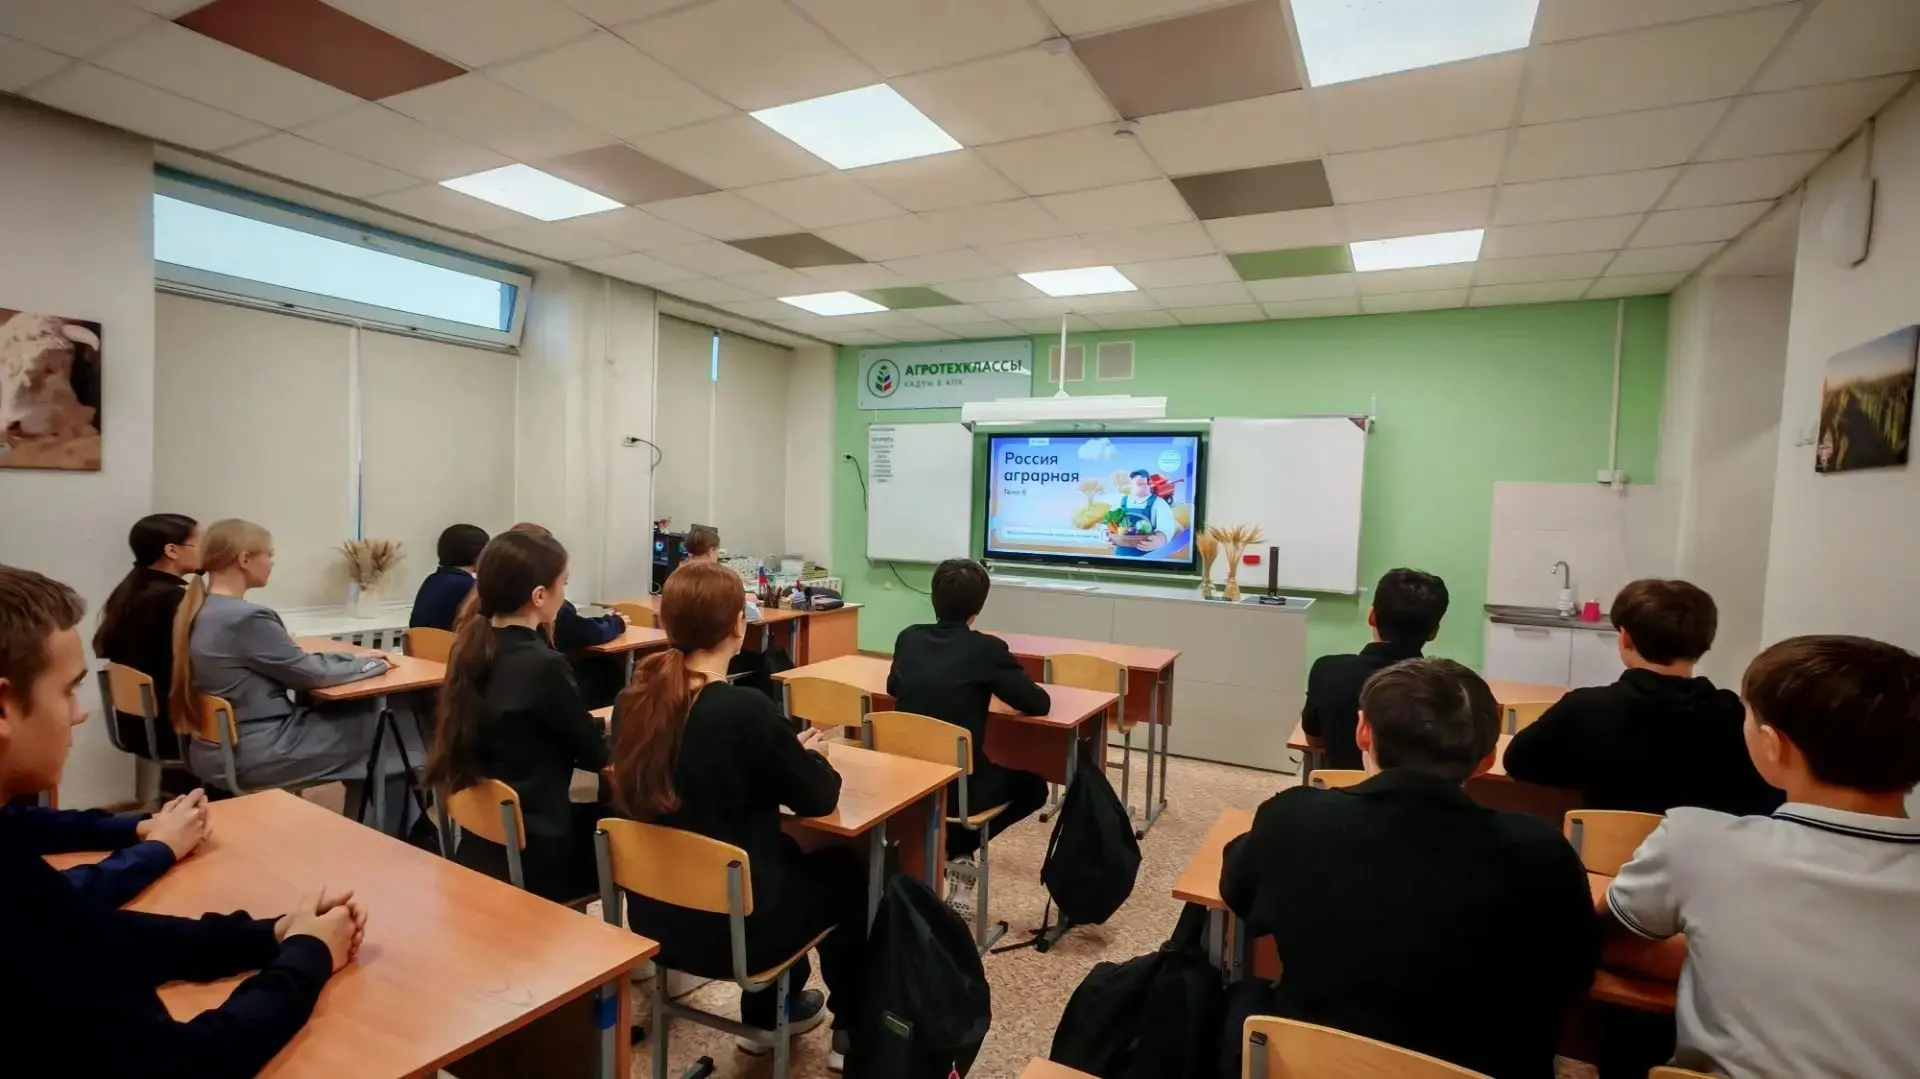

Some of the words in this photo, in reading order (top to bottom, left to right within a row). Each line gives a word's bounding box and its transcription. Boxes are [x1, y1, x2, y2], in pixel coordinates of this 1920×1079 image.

[905, 360, 1022, 376] АГРОТЕХКЛАССЫ
[1005, 452, 1058, 465] Россия
[1004, 471, 1079, 485] аграрная
